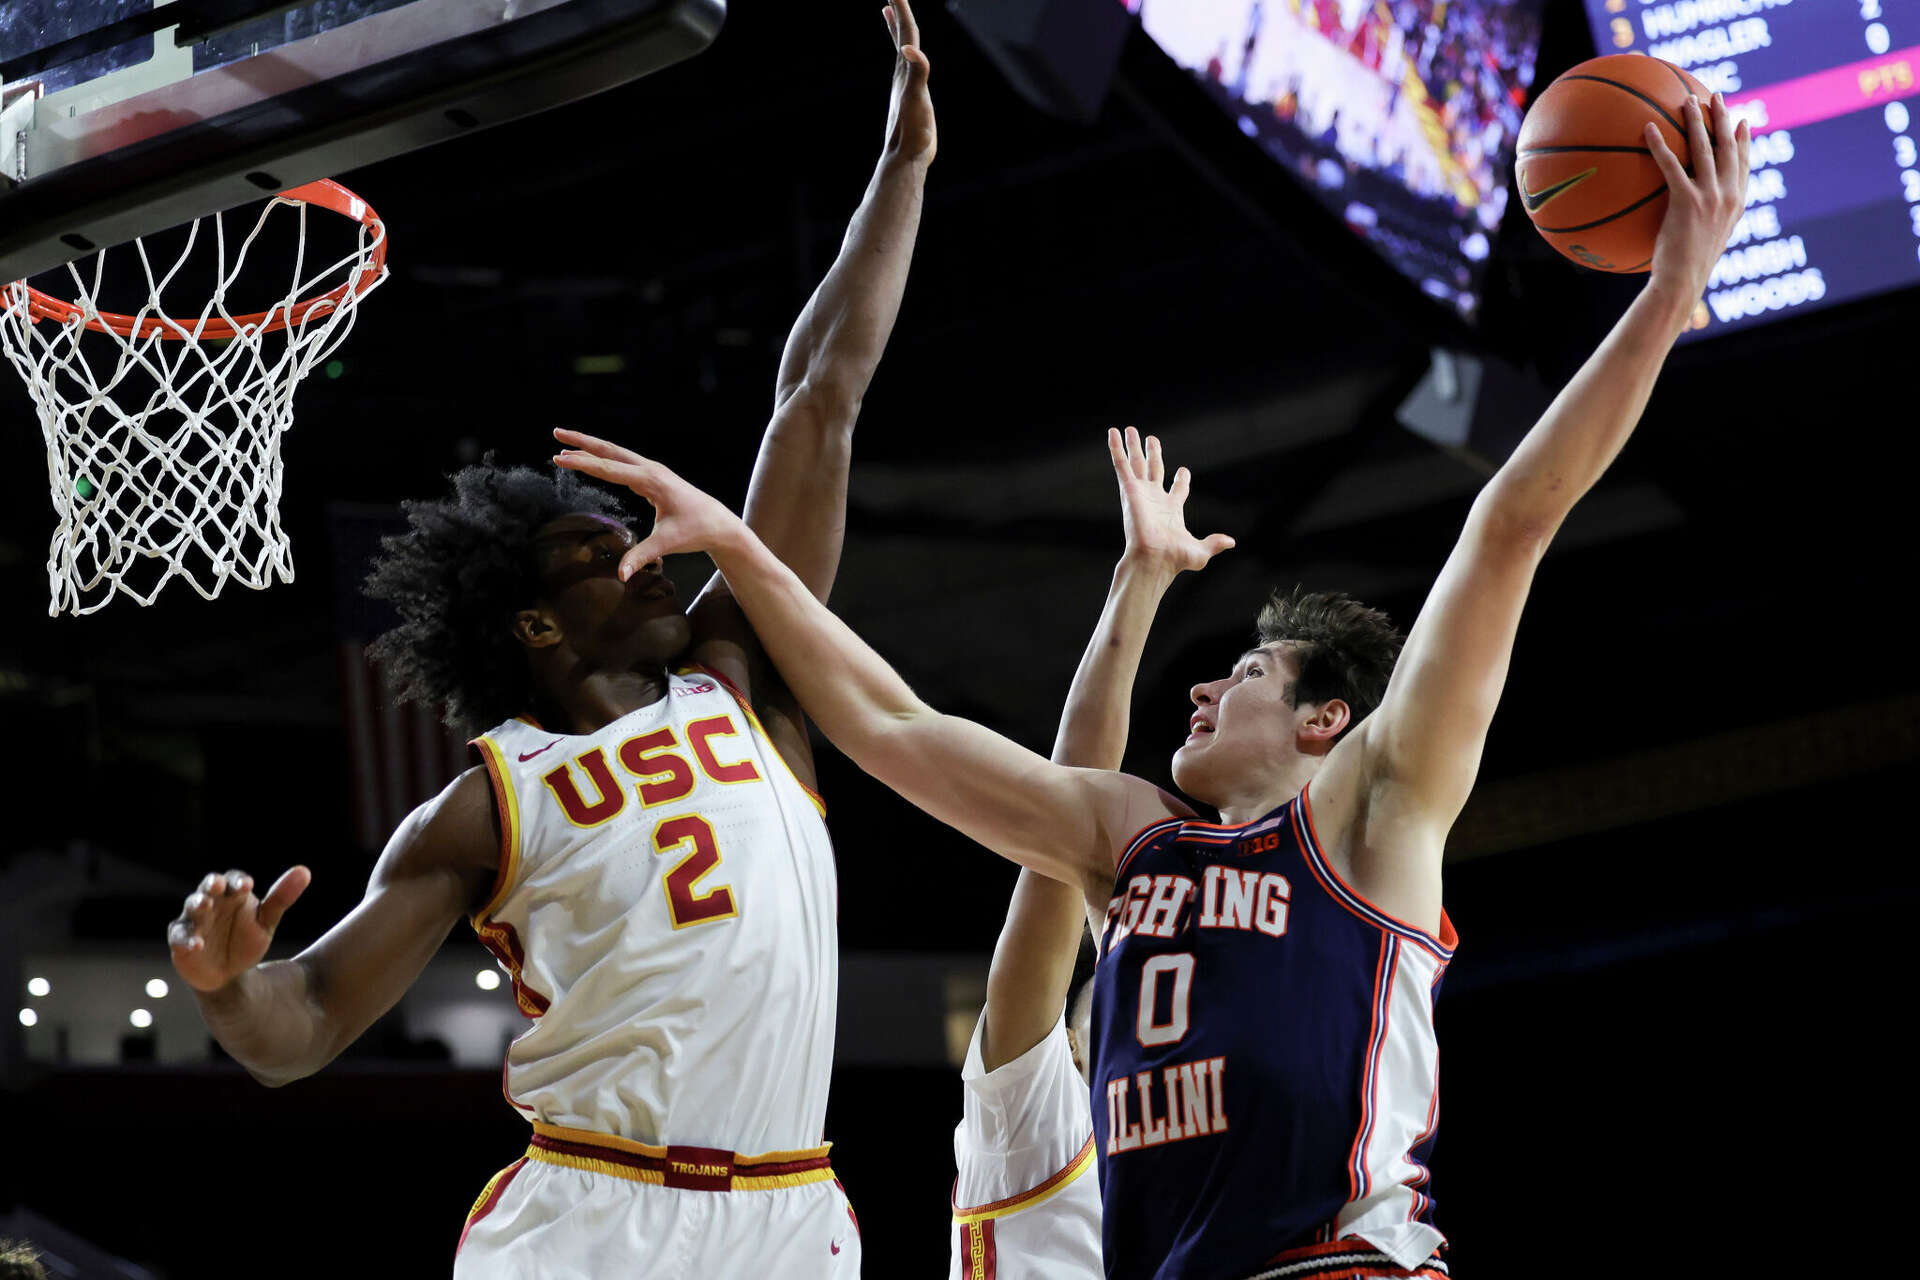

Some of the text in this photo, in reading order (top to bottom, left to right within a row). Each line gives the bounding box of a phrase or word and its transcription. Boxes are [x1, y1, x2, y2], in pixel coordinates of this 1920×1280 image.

[1865, 22, 1890, 54] 0
[1858, 60, 1914, 98] PTS
[1884, 101, 1909, 133] 0
[1708, 267, 1826, 322] WOODS
[540, 714, 763, 829] USC
[651, 812, 739, 931] 2
[1136, 952, 1196, 1048] 0
[1107, 1056, 1229, 1156] ILLINI
[671, 1161, 729, 1177] TROJANS
